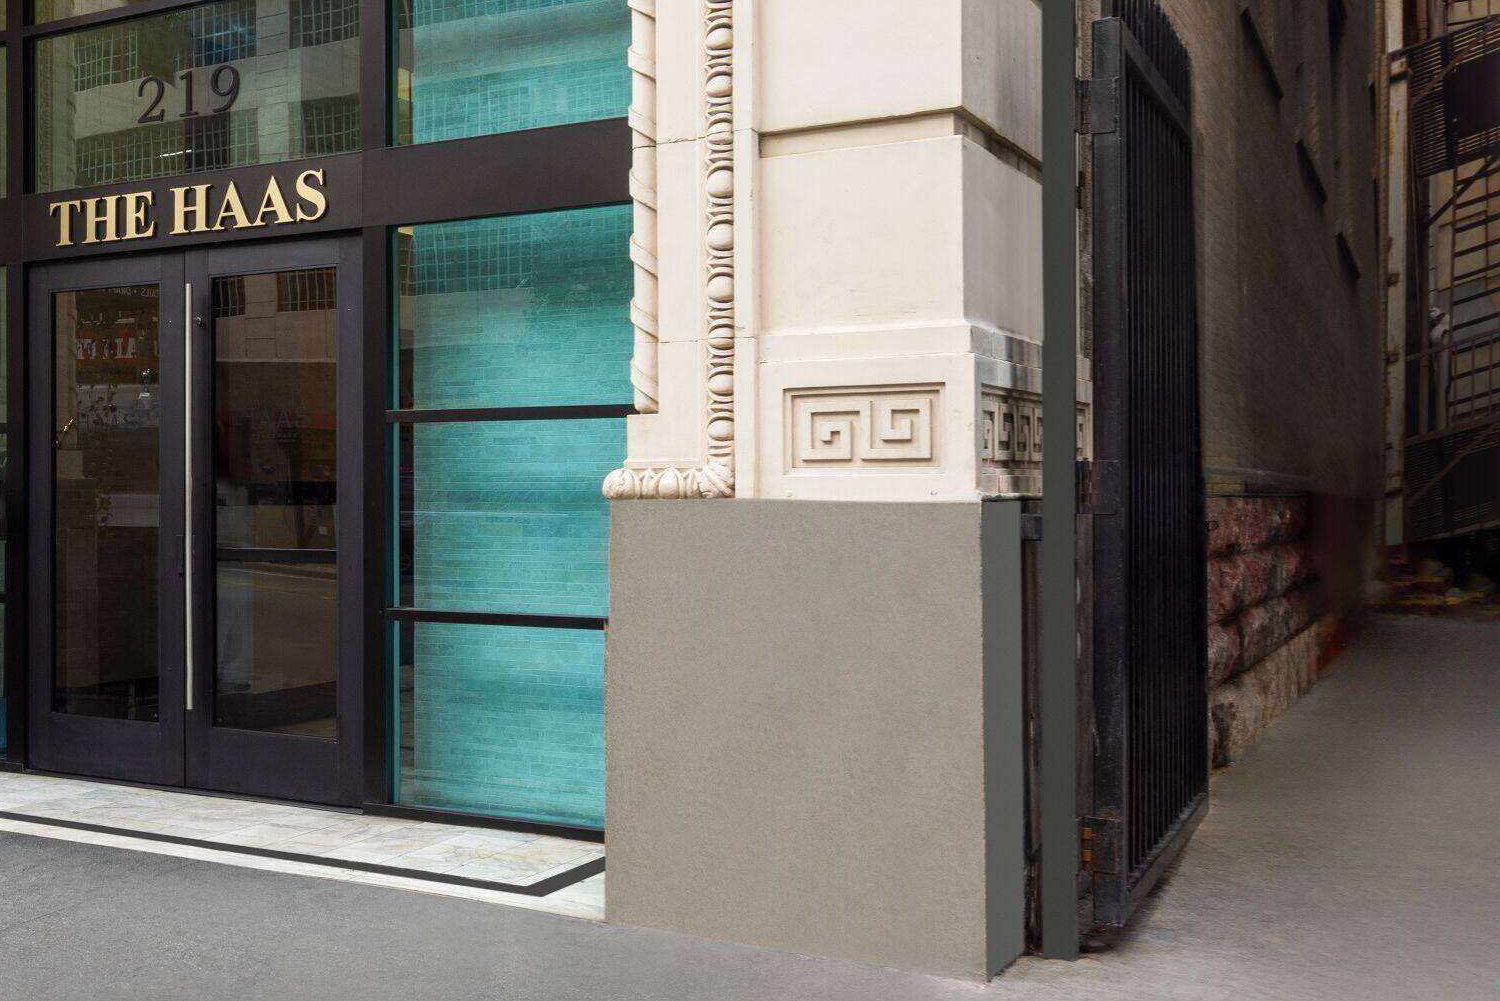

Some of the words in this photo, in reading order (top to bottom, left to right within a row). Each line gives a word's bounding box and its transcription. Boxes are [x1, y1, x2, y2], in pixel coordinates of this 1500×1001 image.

[137, 64, 240, 124] 219
[49, 190, 156, 248] THE
[169, 168, 329, 235] HAAS
